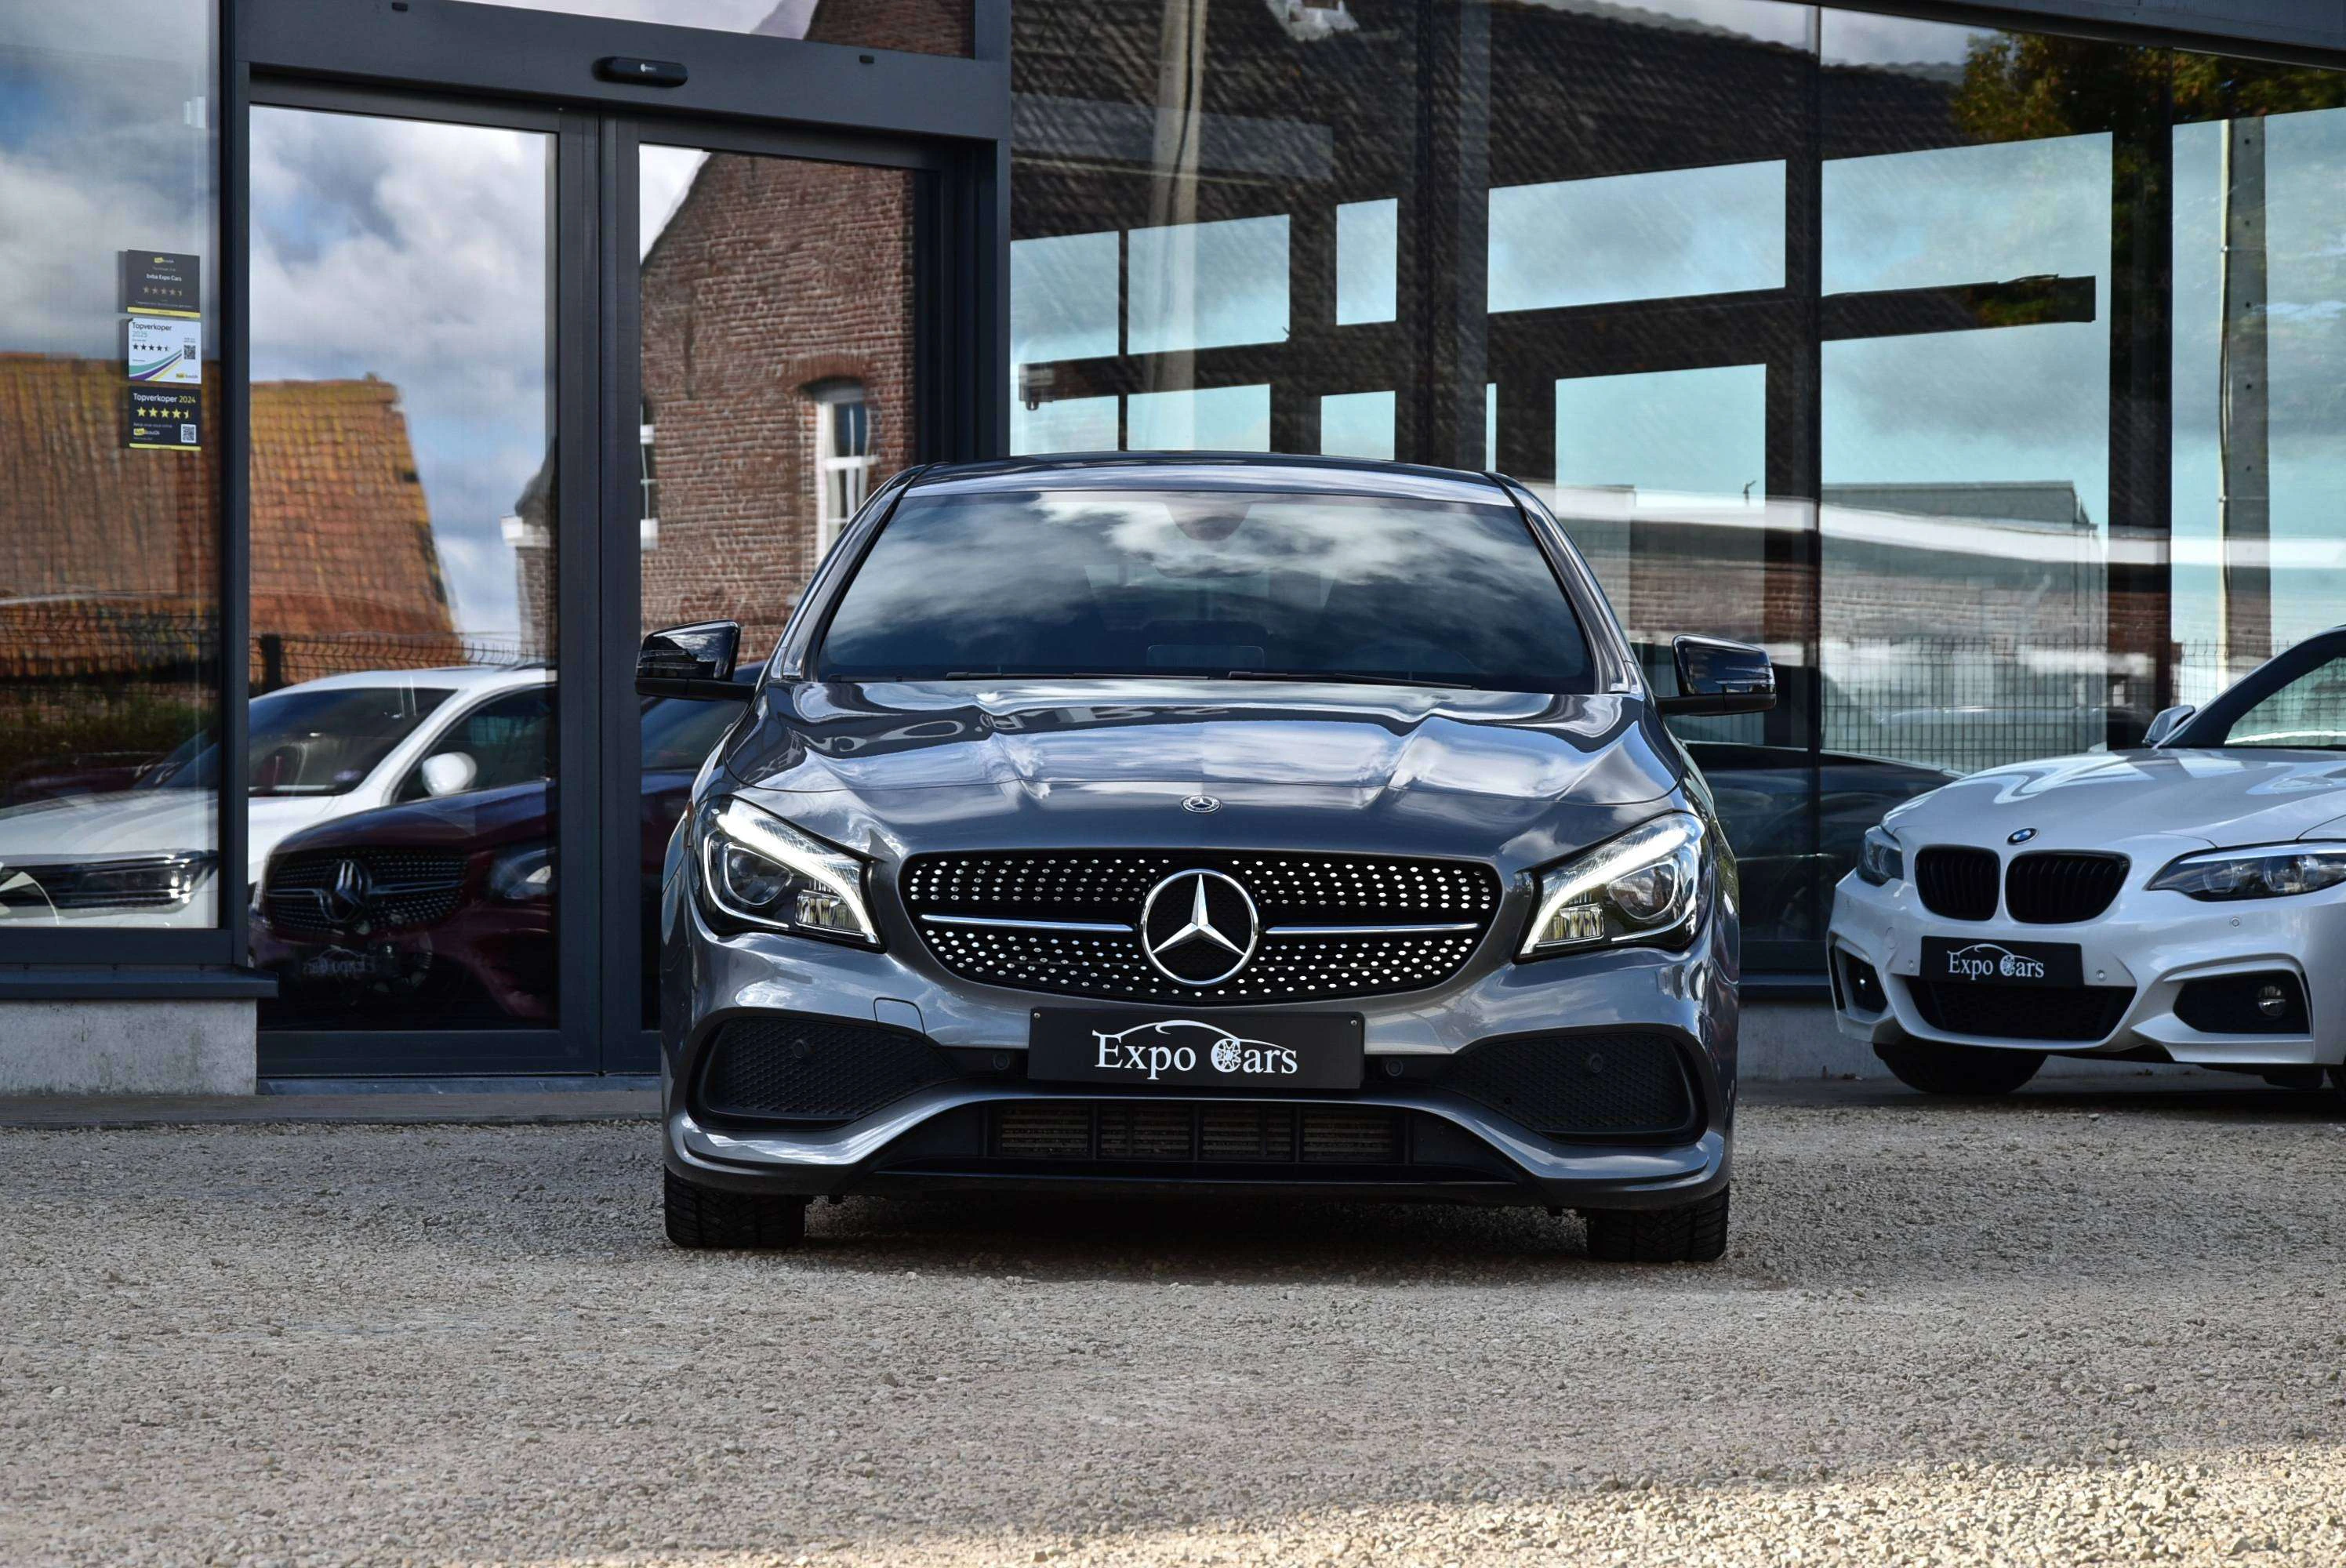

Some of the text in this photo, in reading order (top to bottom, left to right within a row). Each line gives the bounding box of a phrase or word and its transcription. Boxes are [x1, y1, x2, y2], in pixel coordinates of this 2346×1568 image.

[132, 321, 172, 331] Topverkoper
[133, 393, 196, 404] Topverkoper 2024
[1947, 950, 2044, 980] Expo Cars
[1092, 1030, 1298, 1080] Expo Cars
